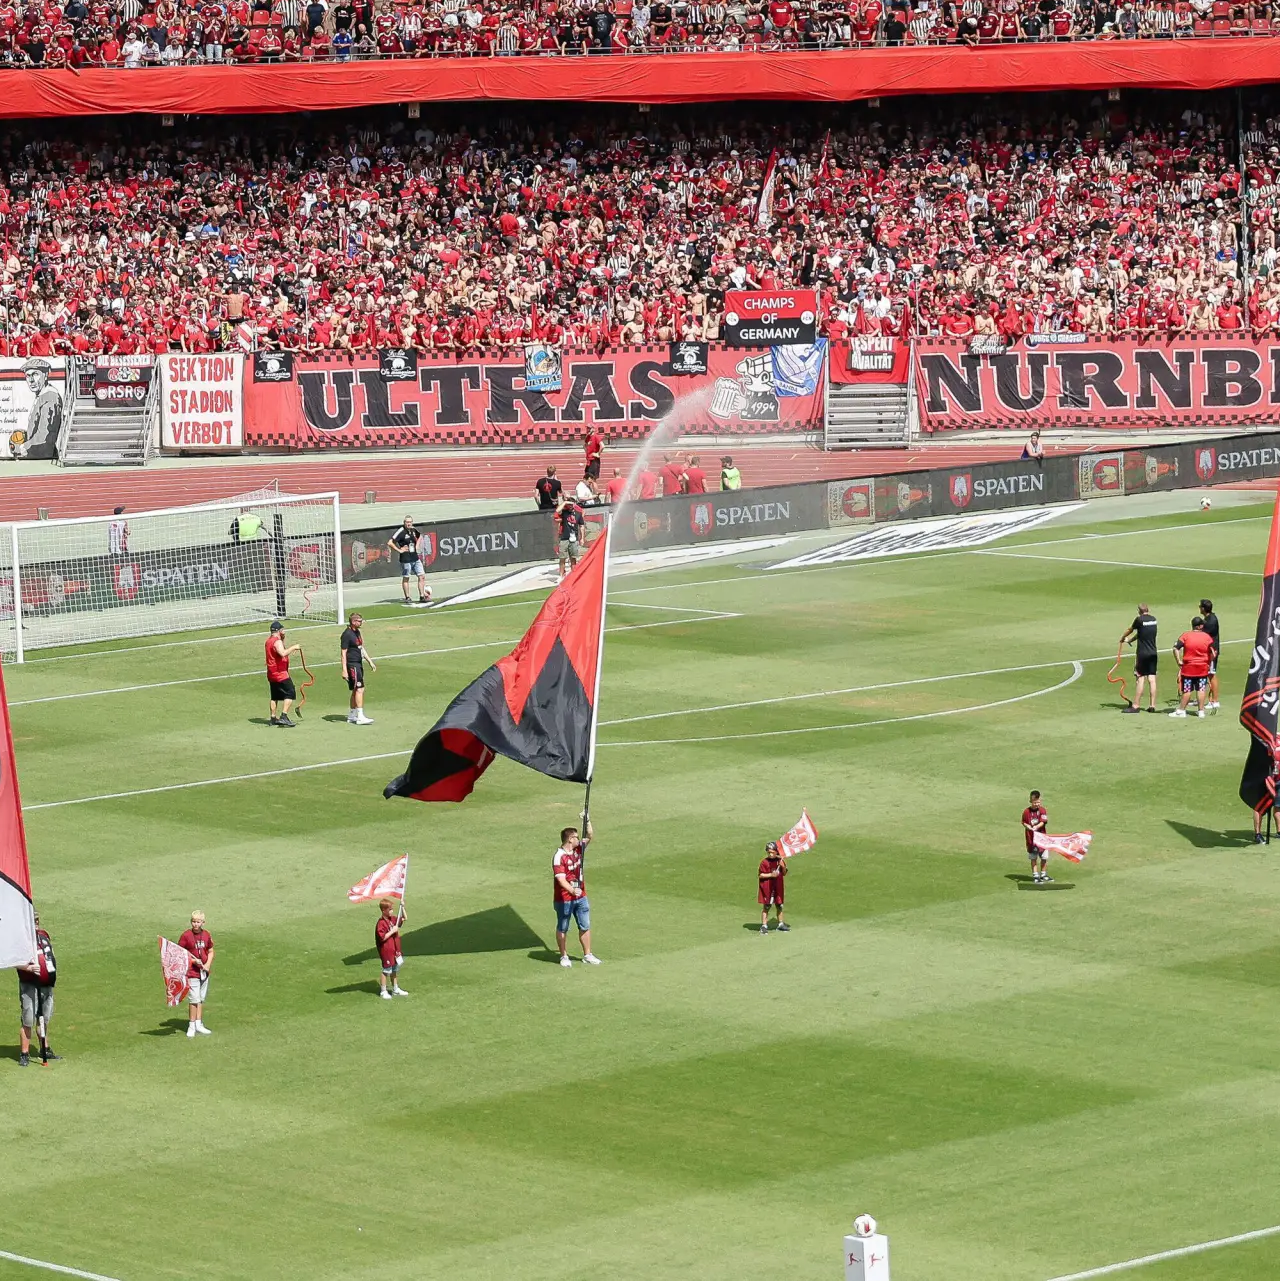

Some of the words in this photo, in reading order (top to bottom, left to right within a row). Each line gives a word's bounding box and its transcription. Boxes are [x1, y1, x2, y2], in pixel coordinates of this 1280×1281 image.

[744, 297, 795, 310] CHAMPS
[761, 313, 778, 324] OF
[740, 328, 800, 340] GERMANY
[168, 357, 234, 384] SEKTION
[108, 385, 134, 398] RSR
[169, 389, 234, 414] STADION
[296, 360, 676, 432] ULTRAS
[750, 401, 776, 416] 1994
[171, 420, 233, 446] VERBOT
[973, 473, 1044, 498] SPATEN
[716, 501, 791, 527] SPATEN
[439, 530, 519, 558] SPATEN
[141, 562, 231, 588] SPATEN
